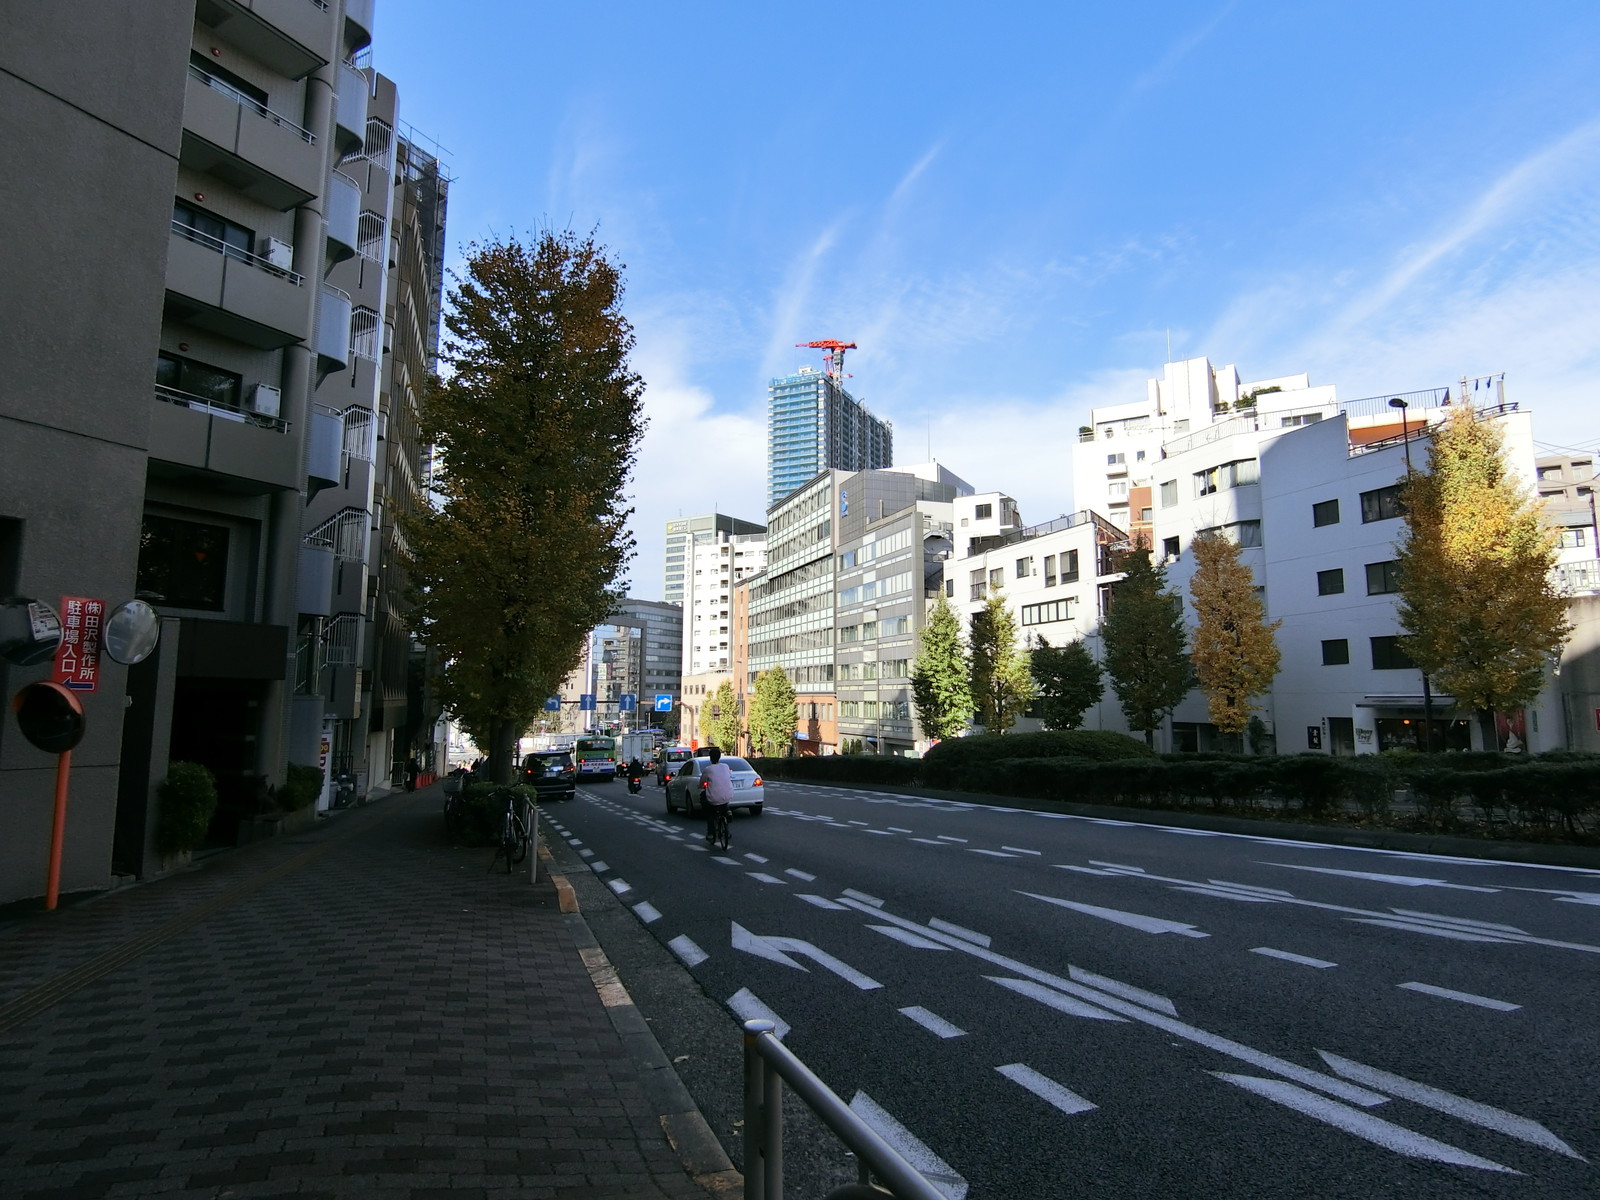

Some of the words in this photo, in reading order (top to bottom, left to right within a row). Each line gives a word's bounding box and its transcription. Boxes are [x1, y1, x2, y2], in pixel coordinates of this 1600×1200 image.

[61, 600, 82, 673] 駐車場入口
